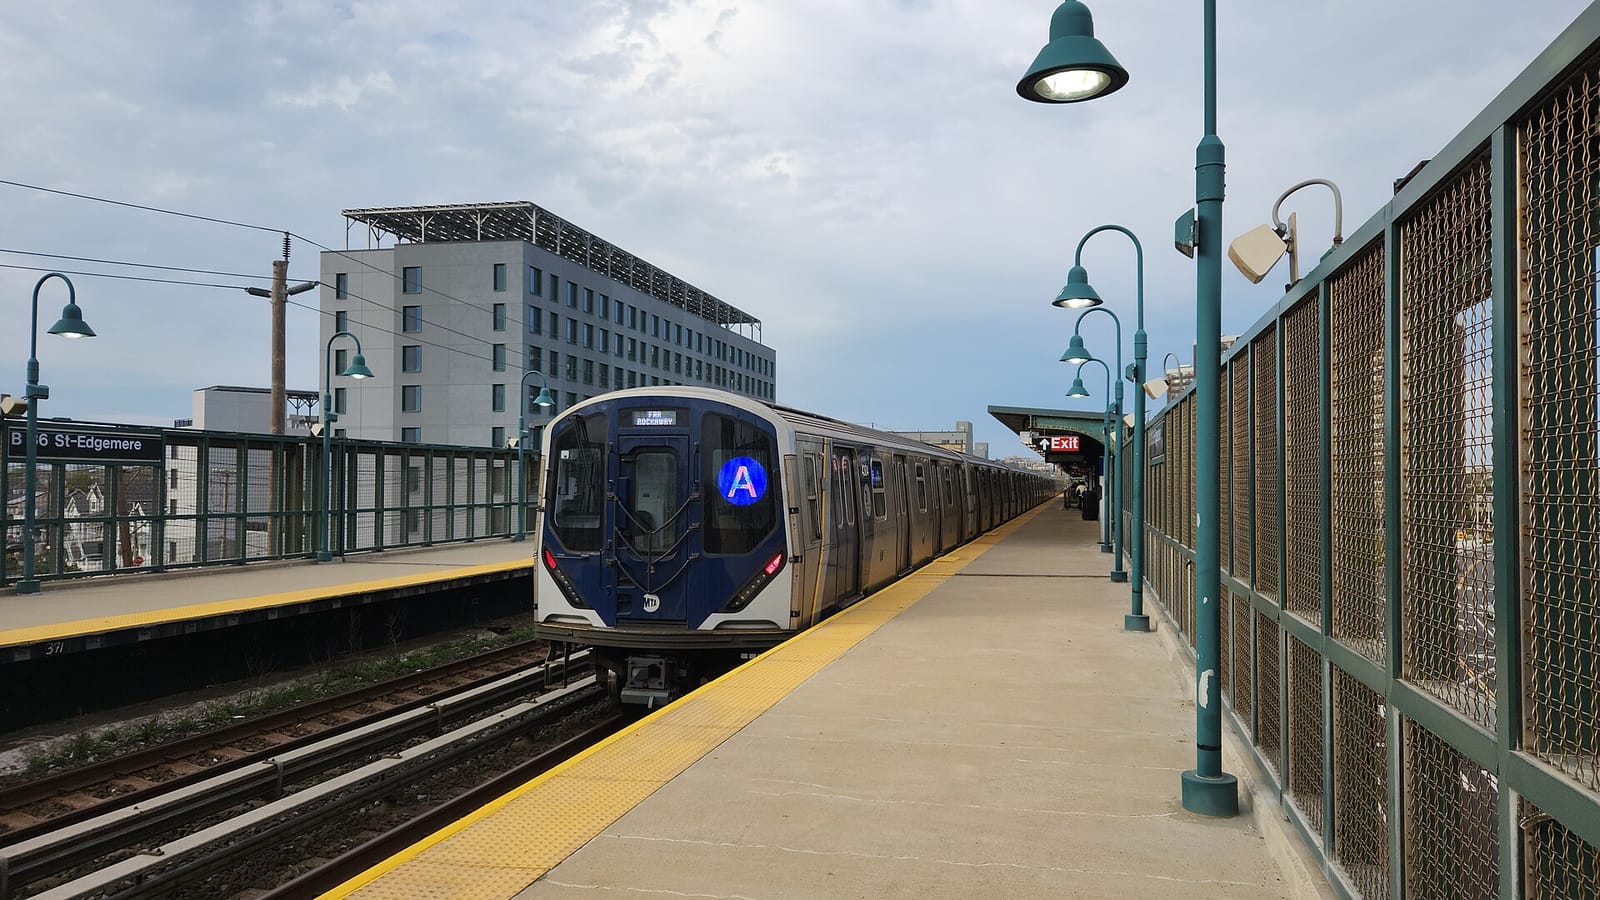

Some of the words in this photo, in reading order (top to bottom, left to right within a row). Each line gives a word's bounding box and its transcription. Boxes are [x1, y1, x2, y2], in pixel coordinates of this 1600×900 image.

[636, 418, 673, 426] ROCKAWAY
[11, 432, 22, 445] B
[35, 433, 48, 447] 6
[55, 433, 142, 451] St-Edgemere
[1051, 437, 1079, 449] Exit
[728, 465, 757, 498] A
[643, 597, 657, 608] MTA
[46, 641, 64, 655] 371
